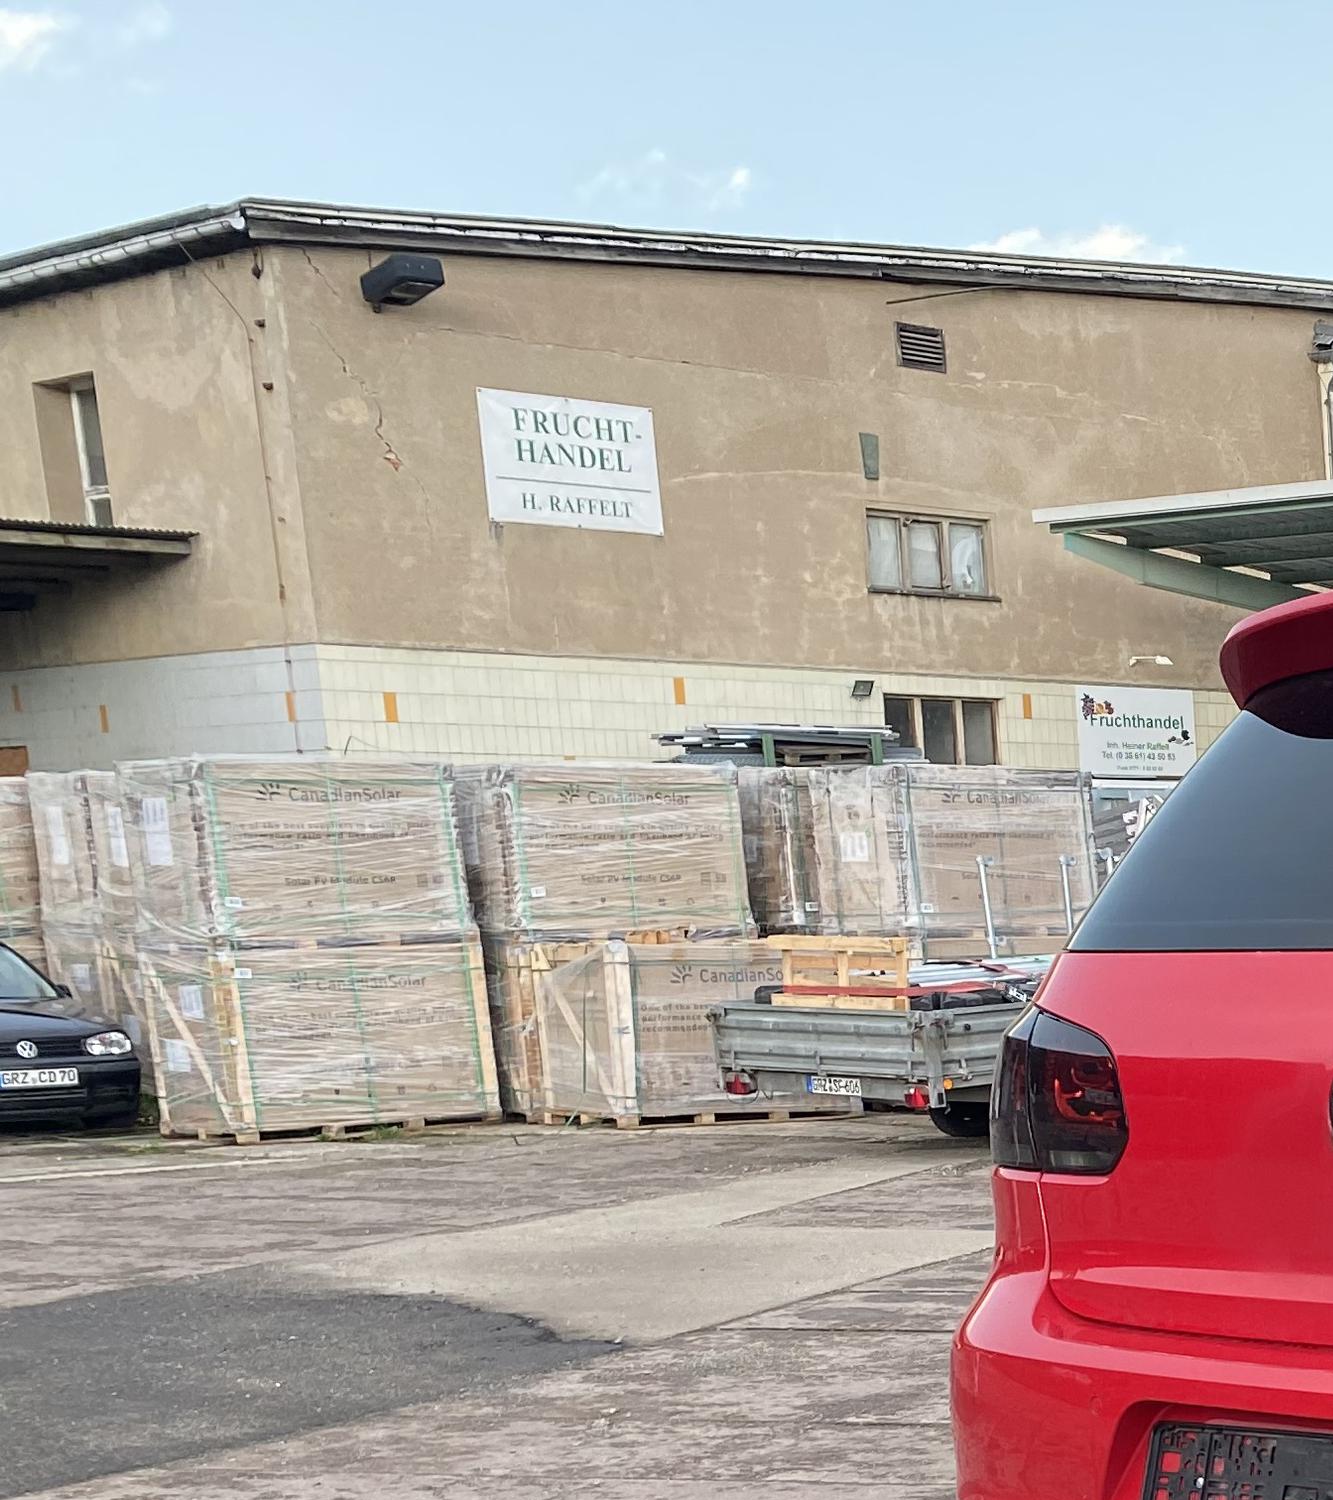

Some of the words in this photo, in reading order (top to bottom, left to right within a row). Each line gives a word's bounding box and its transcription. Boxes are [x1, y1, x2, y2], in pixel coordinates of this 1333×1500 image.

[511, 407, 643, 443] FRUCHT-
[514, 438, 633, 474] HANDEL
[521, 492, 543, 512] H.
[548, 494, 634, 520] RAFFELT
[1090, 713, 1184, 730] Fruchthandel
[289, 786, 402, 802] CanadianSolar
[699, 967, 784, 984] CanadianSo
[1, 1072, 29, 1085] GRZ
[38, 1070, 57, 1083] CD
[58, 1069, 76, 1081] 70
